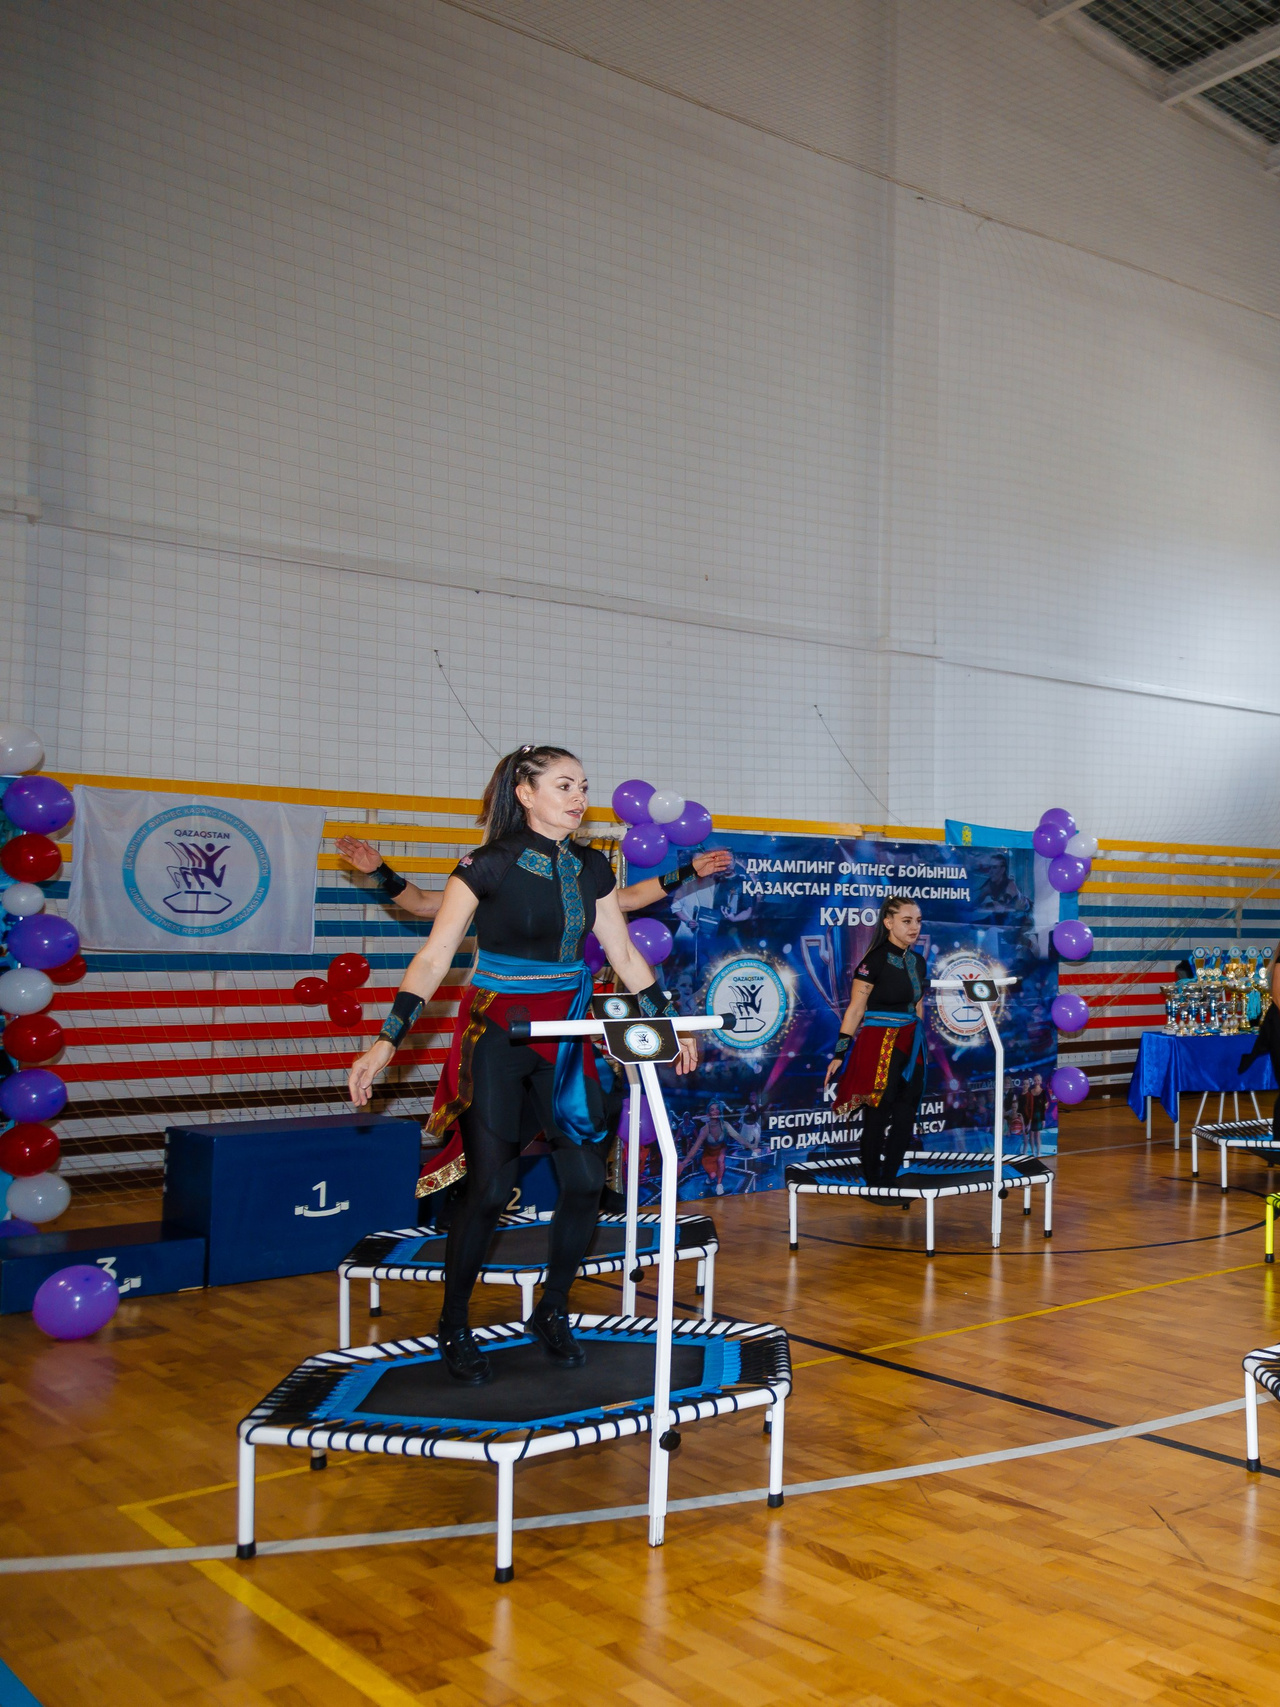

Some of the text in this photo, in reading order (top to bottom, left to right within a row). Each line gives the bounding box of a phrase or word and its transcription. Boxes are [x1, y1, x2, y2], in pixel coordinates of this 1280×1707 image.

[149, 809, 182, 828] ФИТНЕС
[174, 829, 230, 839] QAZAQSTAN
[746, 858, 968, 879] ДЖАМПИНГ ФИТНЕС БОЙЫНША
[742, 881, 970, 901] ҚАЗАҚСТАН РЕСПУБЛИКАСЫНЫҢ
[129, 886, 152, 915] JUMPING
[152, 914, 180, 932] FITNESS
[182, 924, 223, 935] REPUBLIC
[224, 919, 233, 928] OF
[820, 906, 878, 927] КУБО
[770, 1135, 793, 1150] ПО
[795, 1128, 864, 1150] ДЖАМПИ
[312, 1180, 327, 1207] 1
[506, 1187, 522, 1211] 2
[96, 1256, 117, 1279] 3
